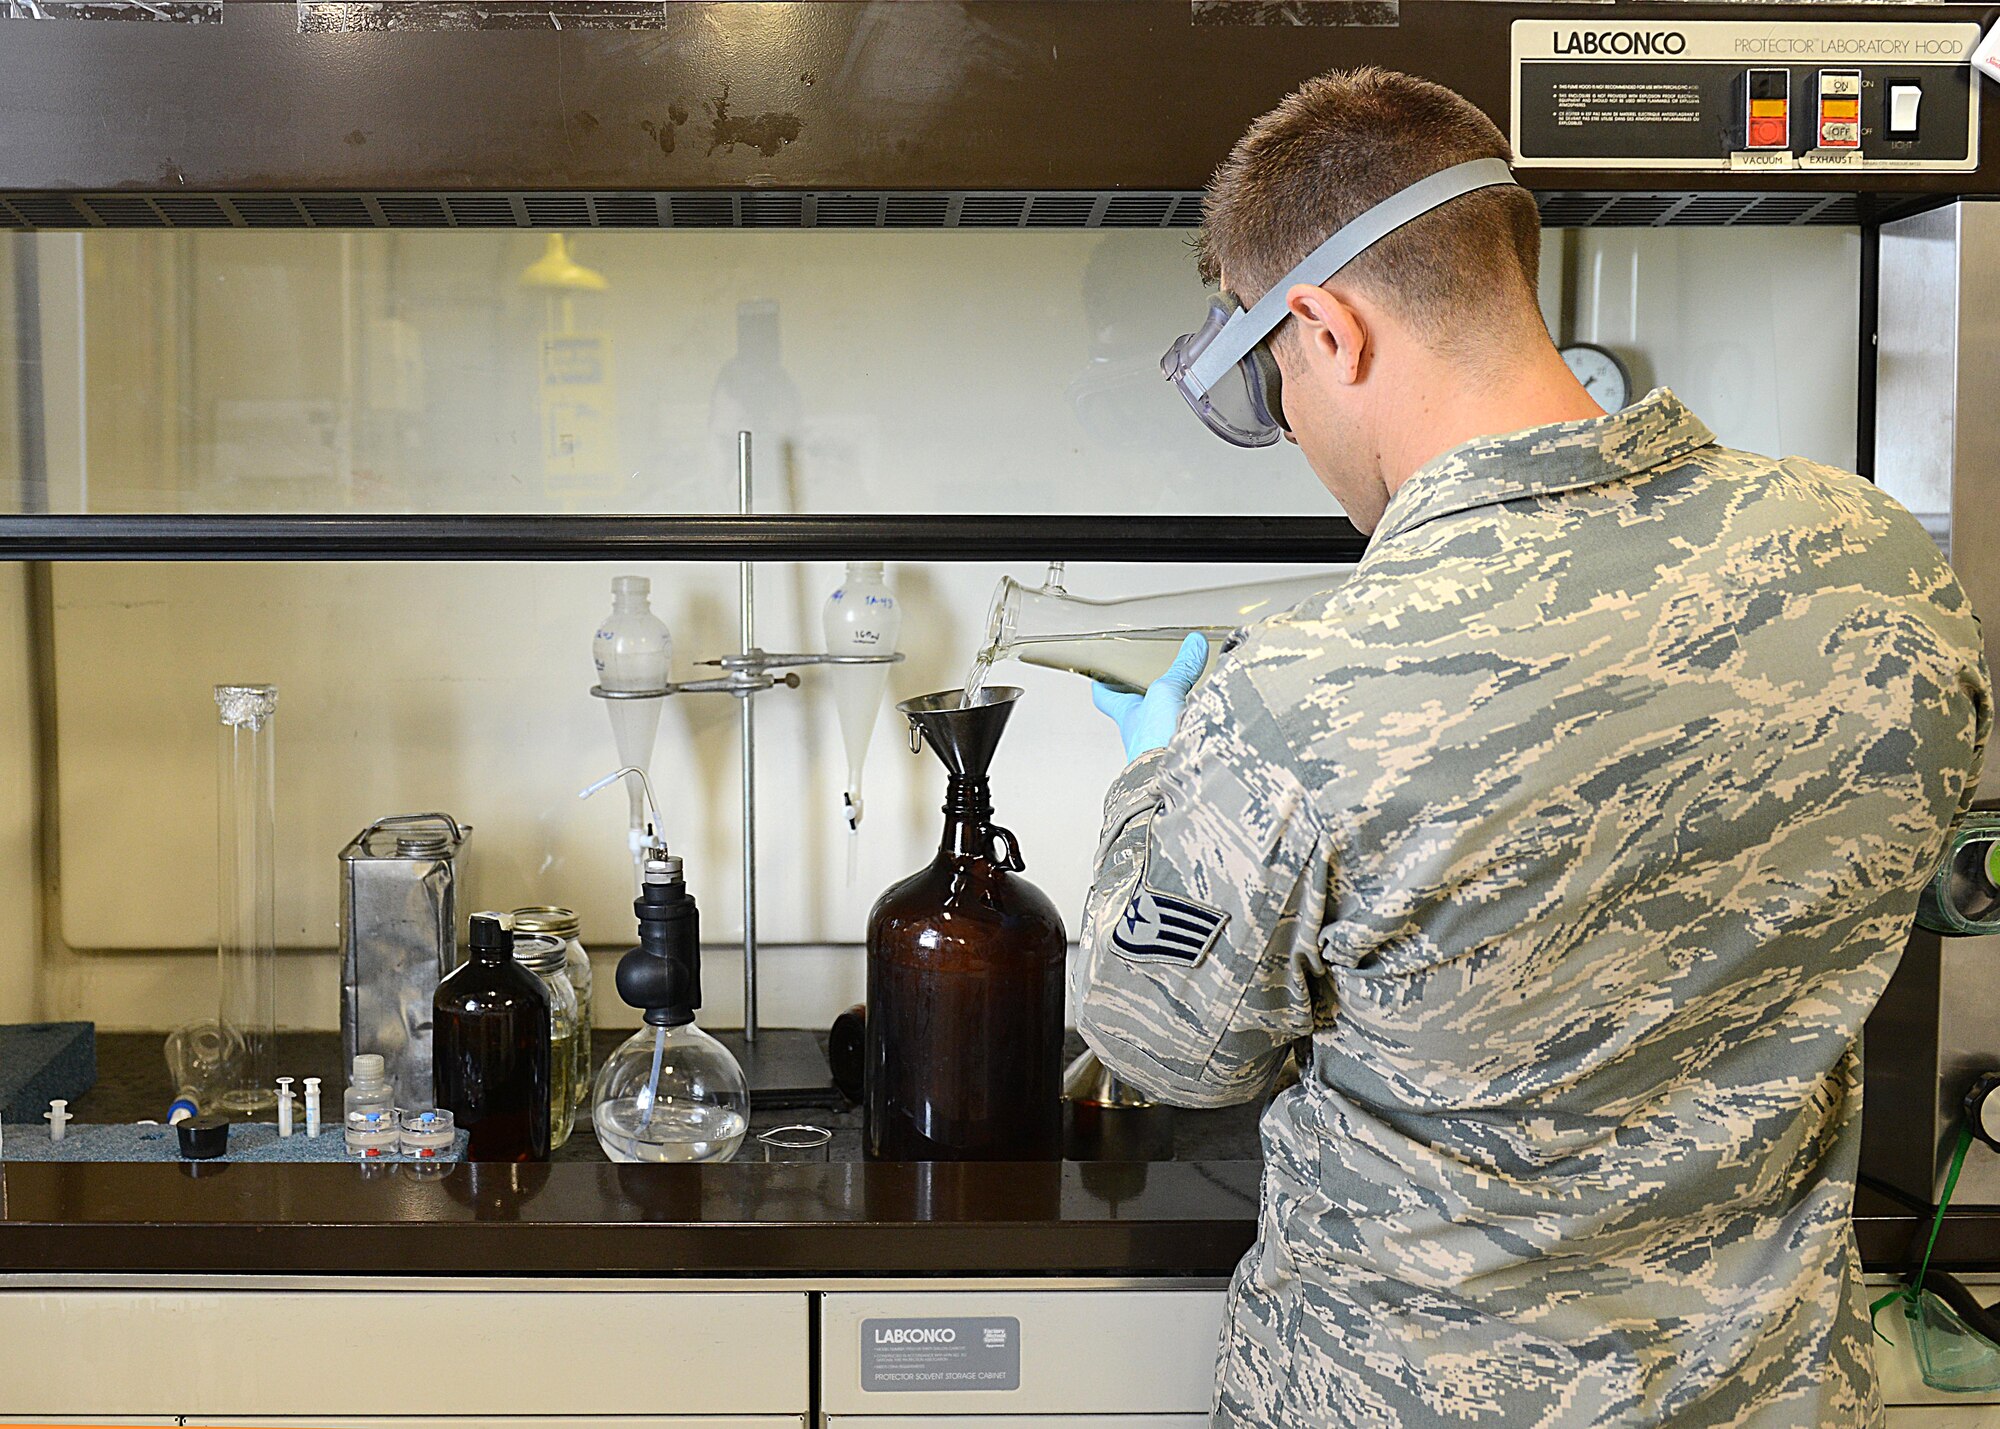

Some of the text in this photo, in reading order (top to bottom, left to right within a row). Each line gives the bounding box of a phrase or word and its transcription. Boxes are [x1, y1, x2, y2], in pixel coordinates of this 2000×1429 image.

[1553, 31, 1686, 54] LABCONCO
[1821, 38, 1910, 53] LABORATORY
[1915, 39, 1963, 54] HOOD
[1833, 82, 1849, 92] ON
[1861, 80, 1874, 88] ON
[1831, 127, 1850, 136] OFF
[1861, 127, 1873, 136] OFF
[1892, 141, 1912, 150] LIGHT
[1742, 156, 1783, 165] VACUUM
[1809, 155, 1853, 165] EXHAUST
[875, 1328, 956, 1344] LABCONCO
[875, 1373, 914, 1381] PROTECTOR
[946, 1372, 976, 1380] STORAGE
[978, 1371, 1006, 1380] CABINET
